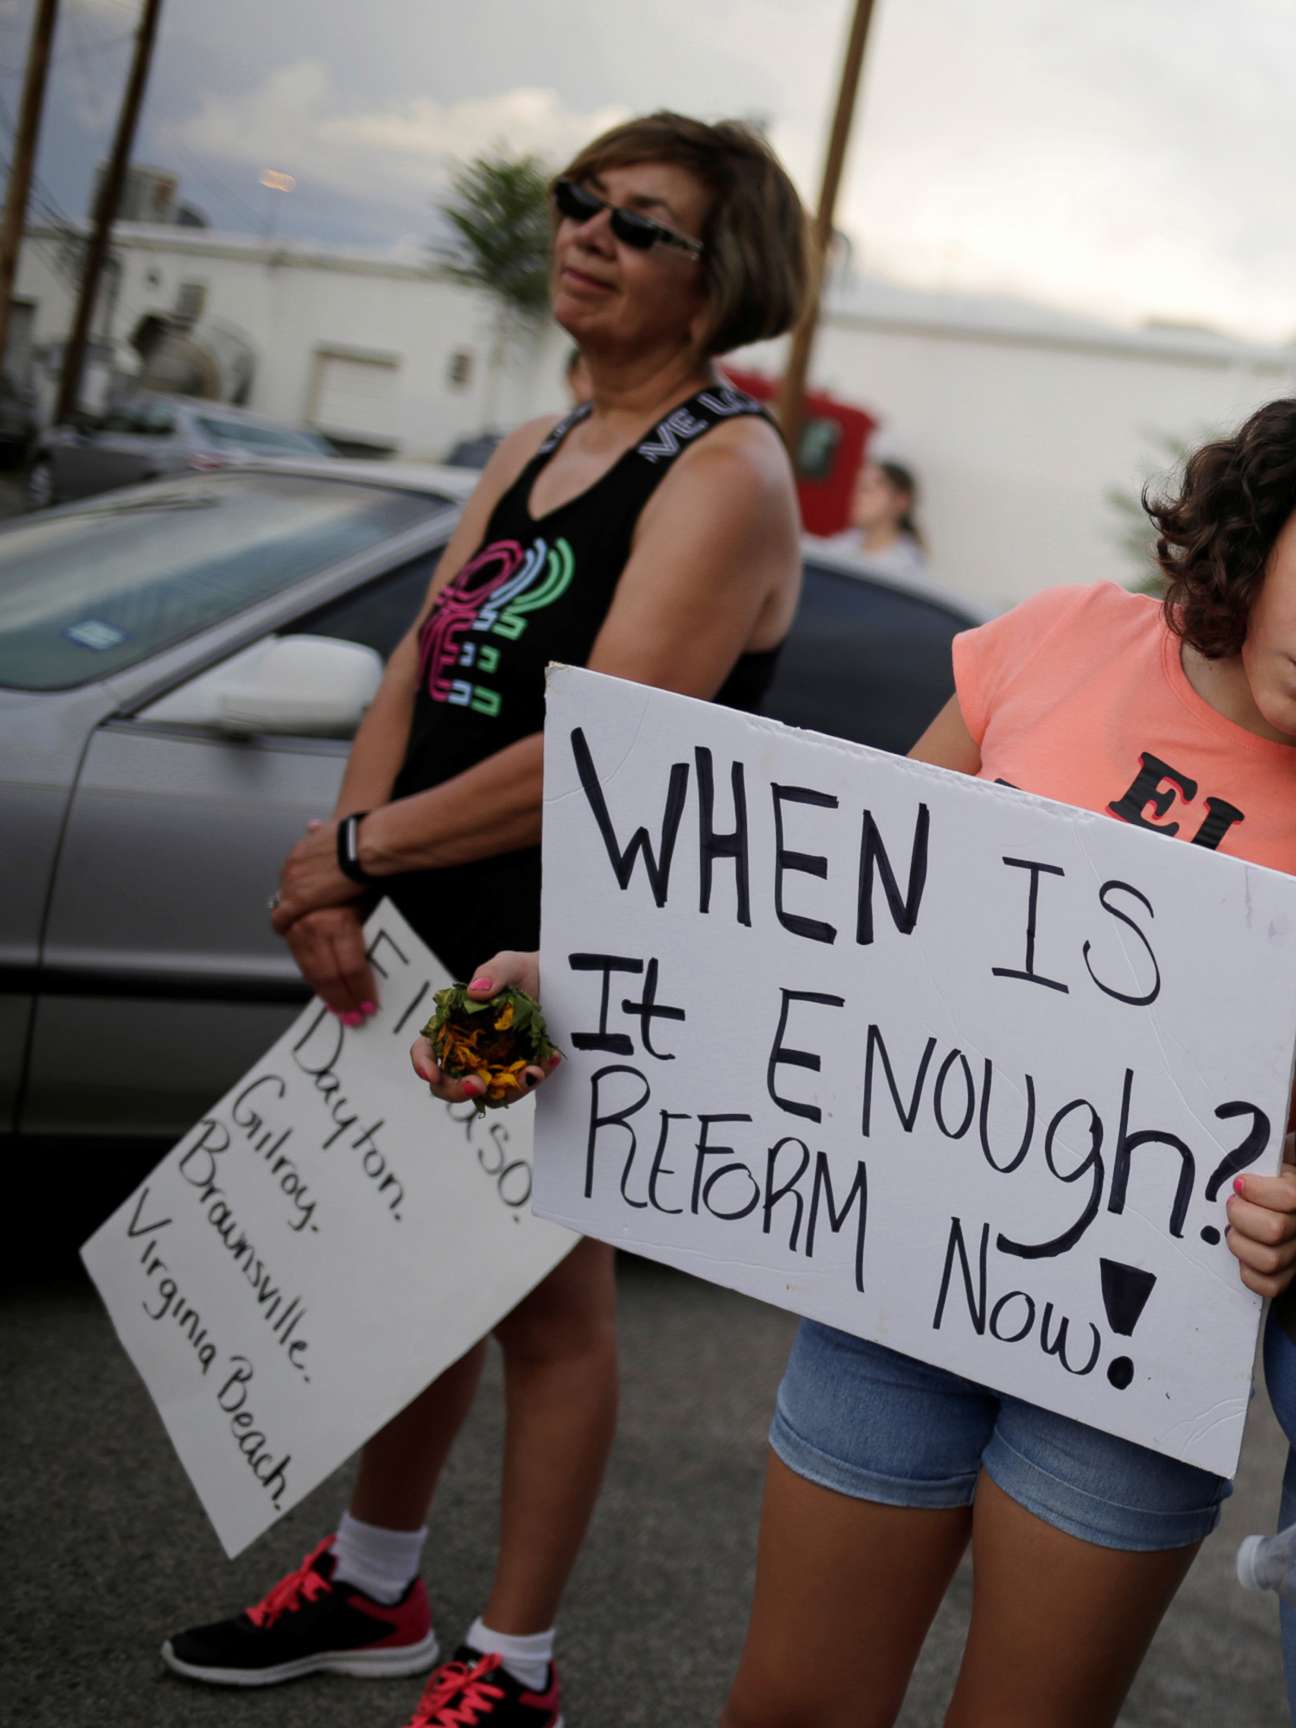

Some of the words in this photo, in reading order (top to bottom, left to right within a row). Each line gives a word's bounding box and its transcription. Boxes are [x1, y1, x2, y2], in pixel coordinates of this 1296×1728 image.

[570, 727, 930, 946] WHEN
[992, 855, 1161, 1007] IS
[127, 1186, 217, 1375] Virginia
[584, 1064, 868, 1293] REFORM
[932, 1216, 1157, 1391] Now!
